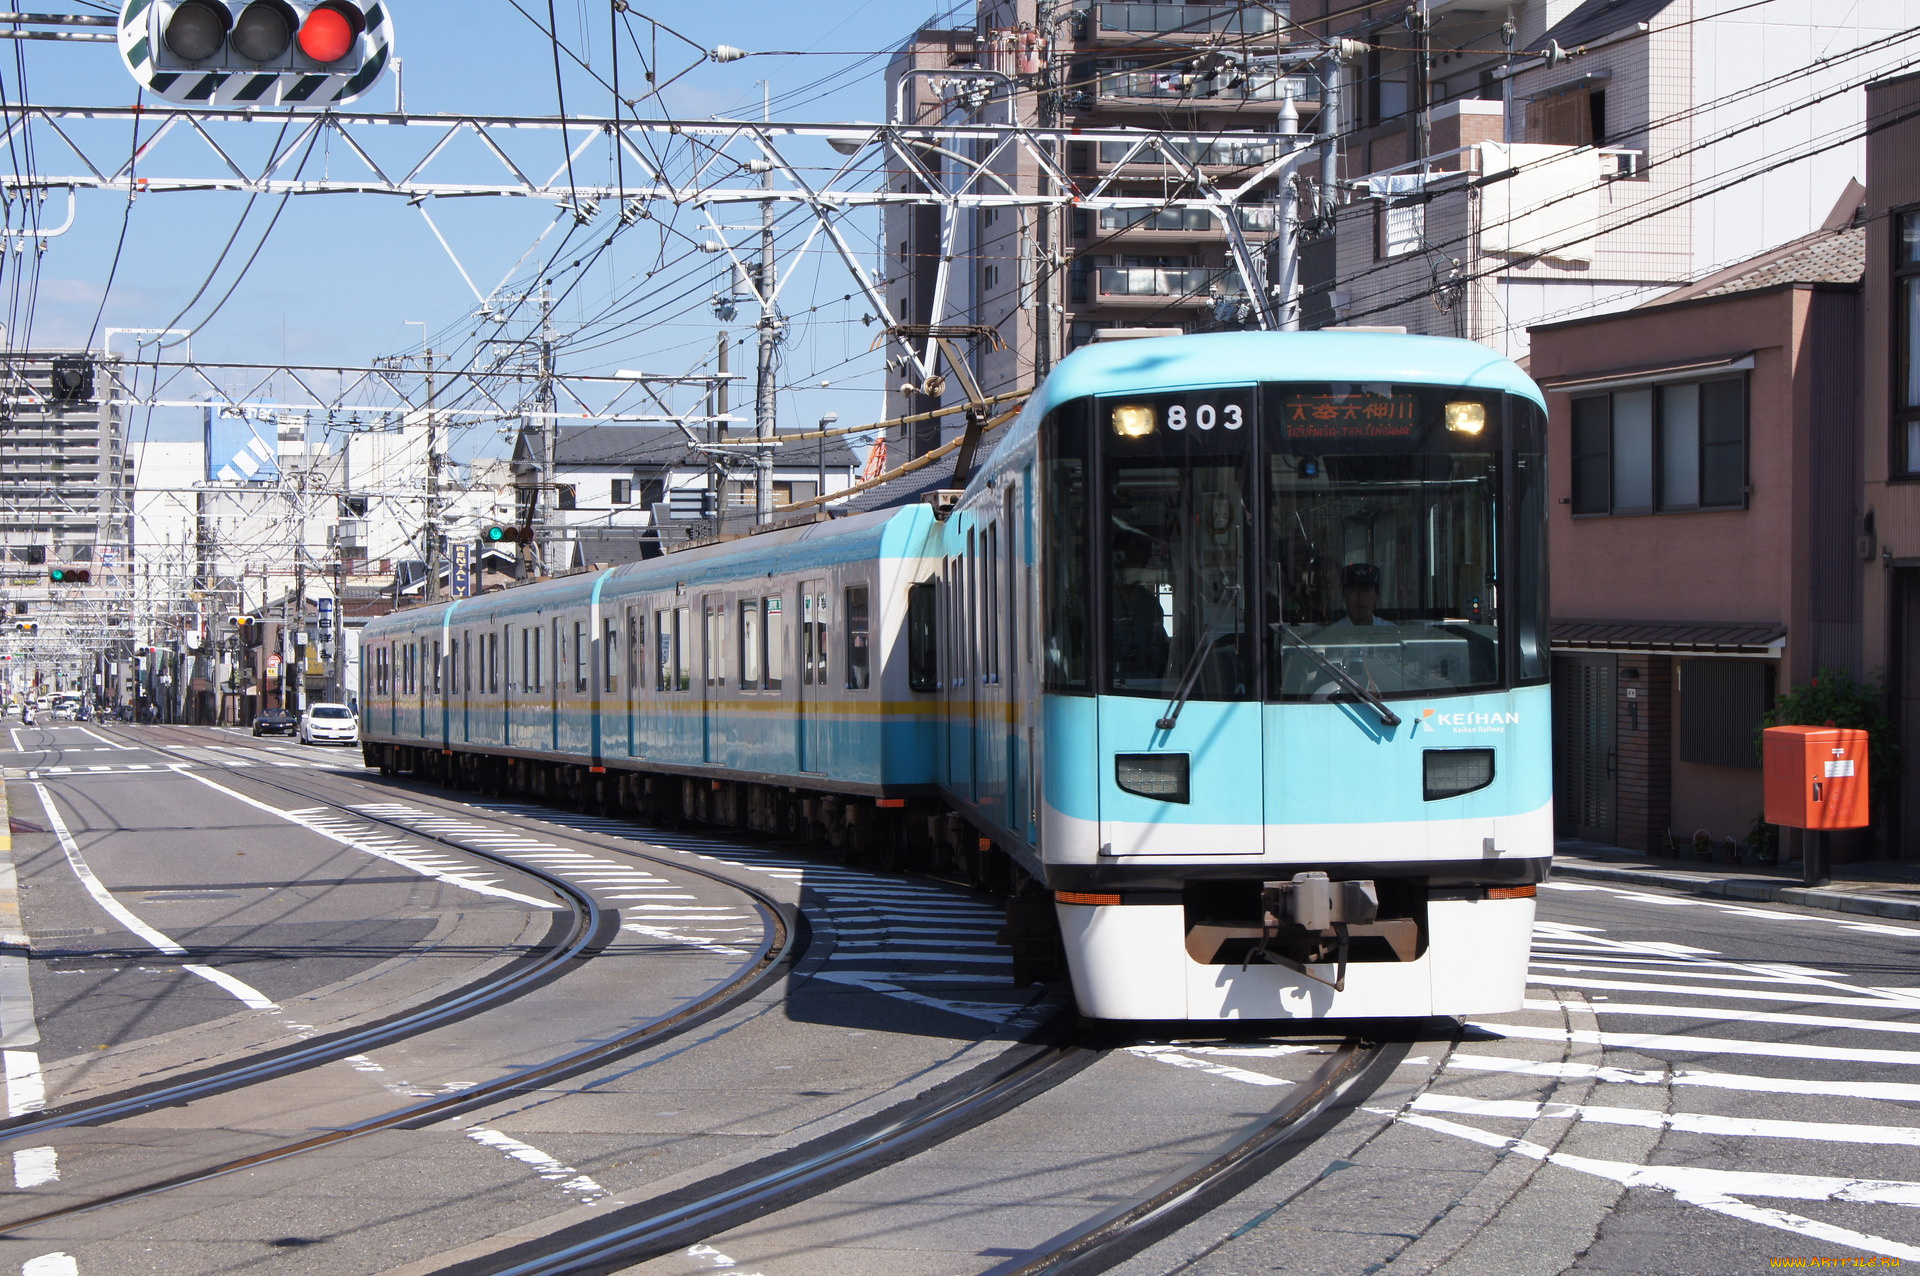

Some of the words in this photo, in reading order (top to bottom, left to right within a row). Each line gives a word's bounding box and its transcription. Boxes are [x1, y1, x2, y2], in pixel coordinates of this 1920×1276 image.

[1167, 404, 1243, 431] 803
[455, 546, 467, 582] RENTAL
[1438, 711, 1520, 726] KEIHAN
[1453, 726, 1477, 734] Keihan
[1478, 725, 1505, 734] Railway
